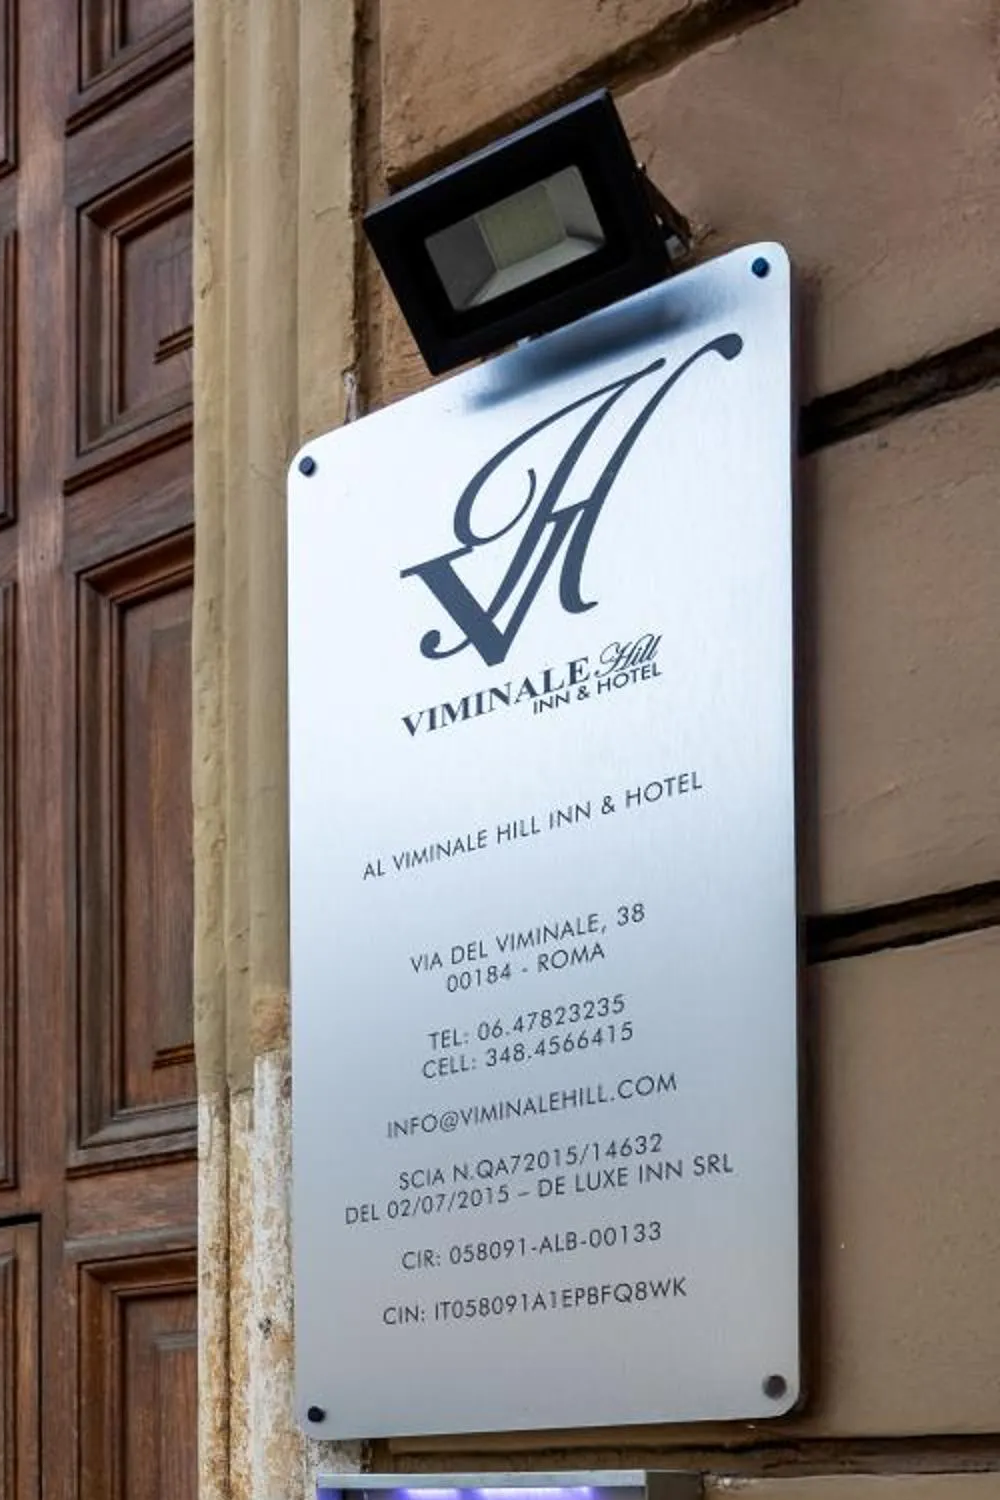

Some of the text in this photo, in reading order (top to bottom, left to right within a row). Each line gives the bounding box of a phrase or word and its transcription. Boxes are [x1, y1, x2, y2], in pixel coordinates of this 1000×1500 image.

[401, 633, 663, 738] VIMINALE Hill
[533, 662, 663, 715] INN & HOTEL
[363, 771, 703, 880] AL VIMINALE HILL INN & HOTEL
[410, 902, 645, 973] VIA DEL VIMINALE, 38
[447, 963, 512, 993] 00184
[537, 942, 605, 972] ROMA
[422, 1020, 634, 1079] CELL: 348.4566415
[427, 993, 626, 1051] TEL: 06.47823235
[388, 1072, 677, 1138] INFO@VIMINALEHILL.COM
[346, 1204, 380, 1224] DEL
[387, 1184, 509, 1219] 02/07/2015
[538, 1176, 565, 1198] DE
[576, 1167, 628, 1192] LUXE
[639, 1160, 682, 1184] INN
[693, 1153, 733, 1176] SRL
[399, 1132, 663, 1191] SCIA N.QA72015/14632
[402, 1221, 661, 1270] CIR: 058091-ALB-00133
[383, 1305, 425, 1325] CIN:
